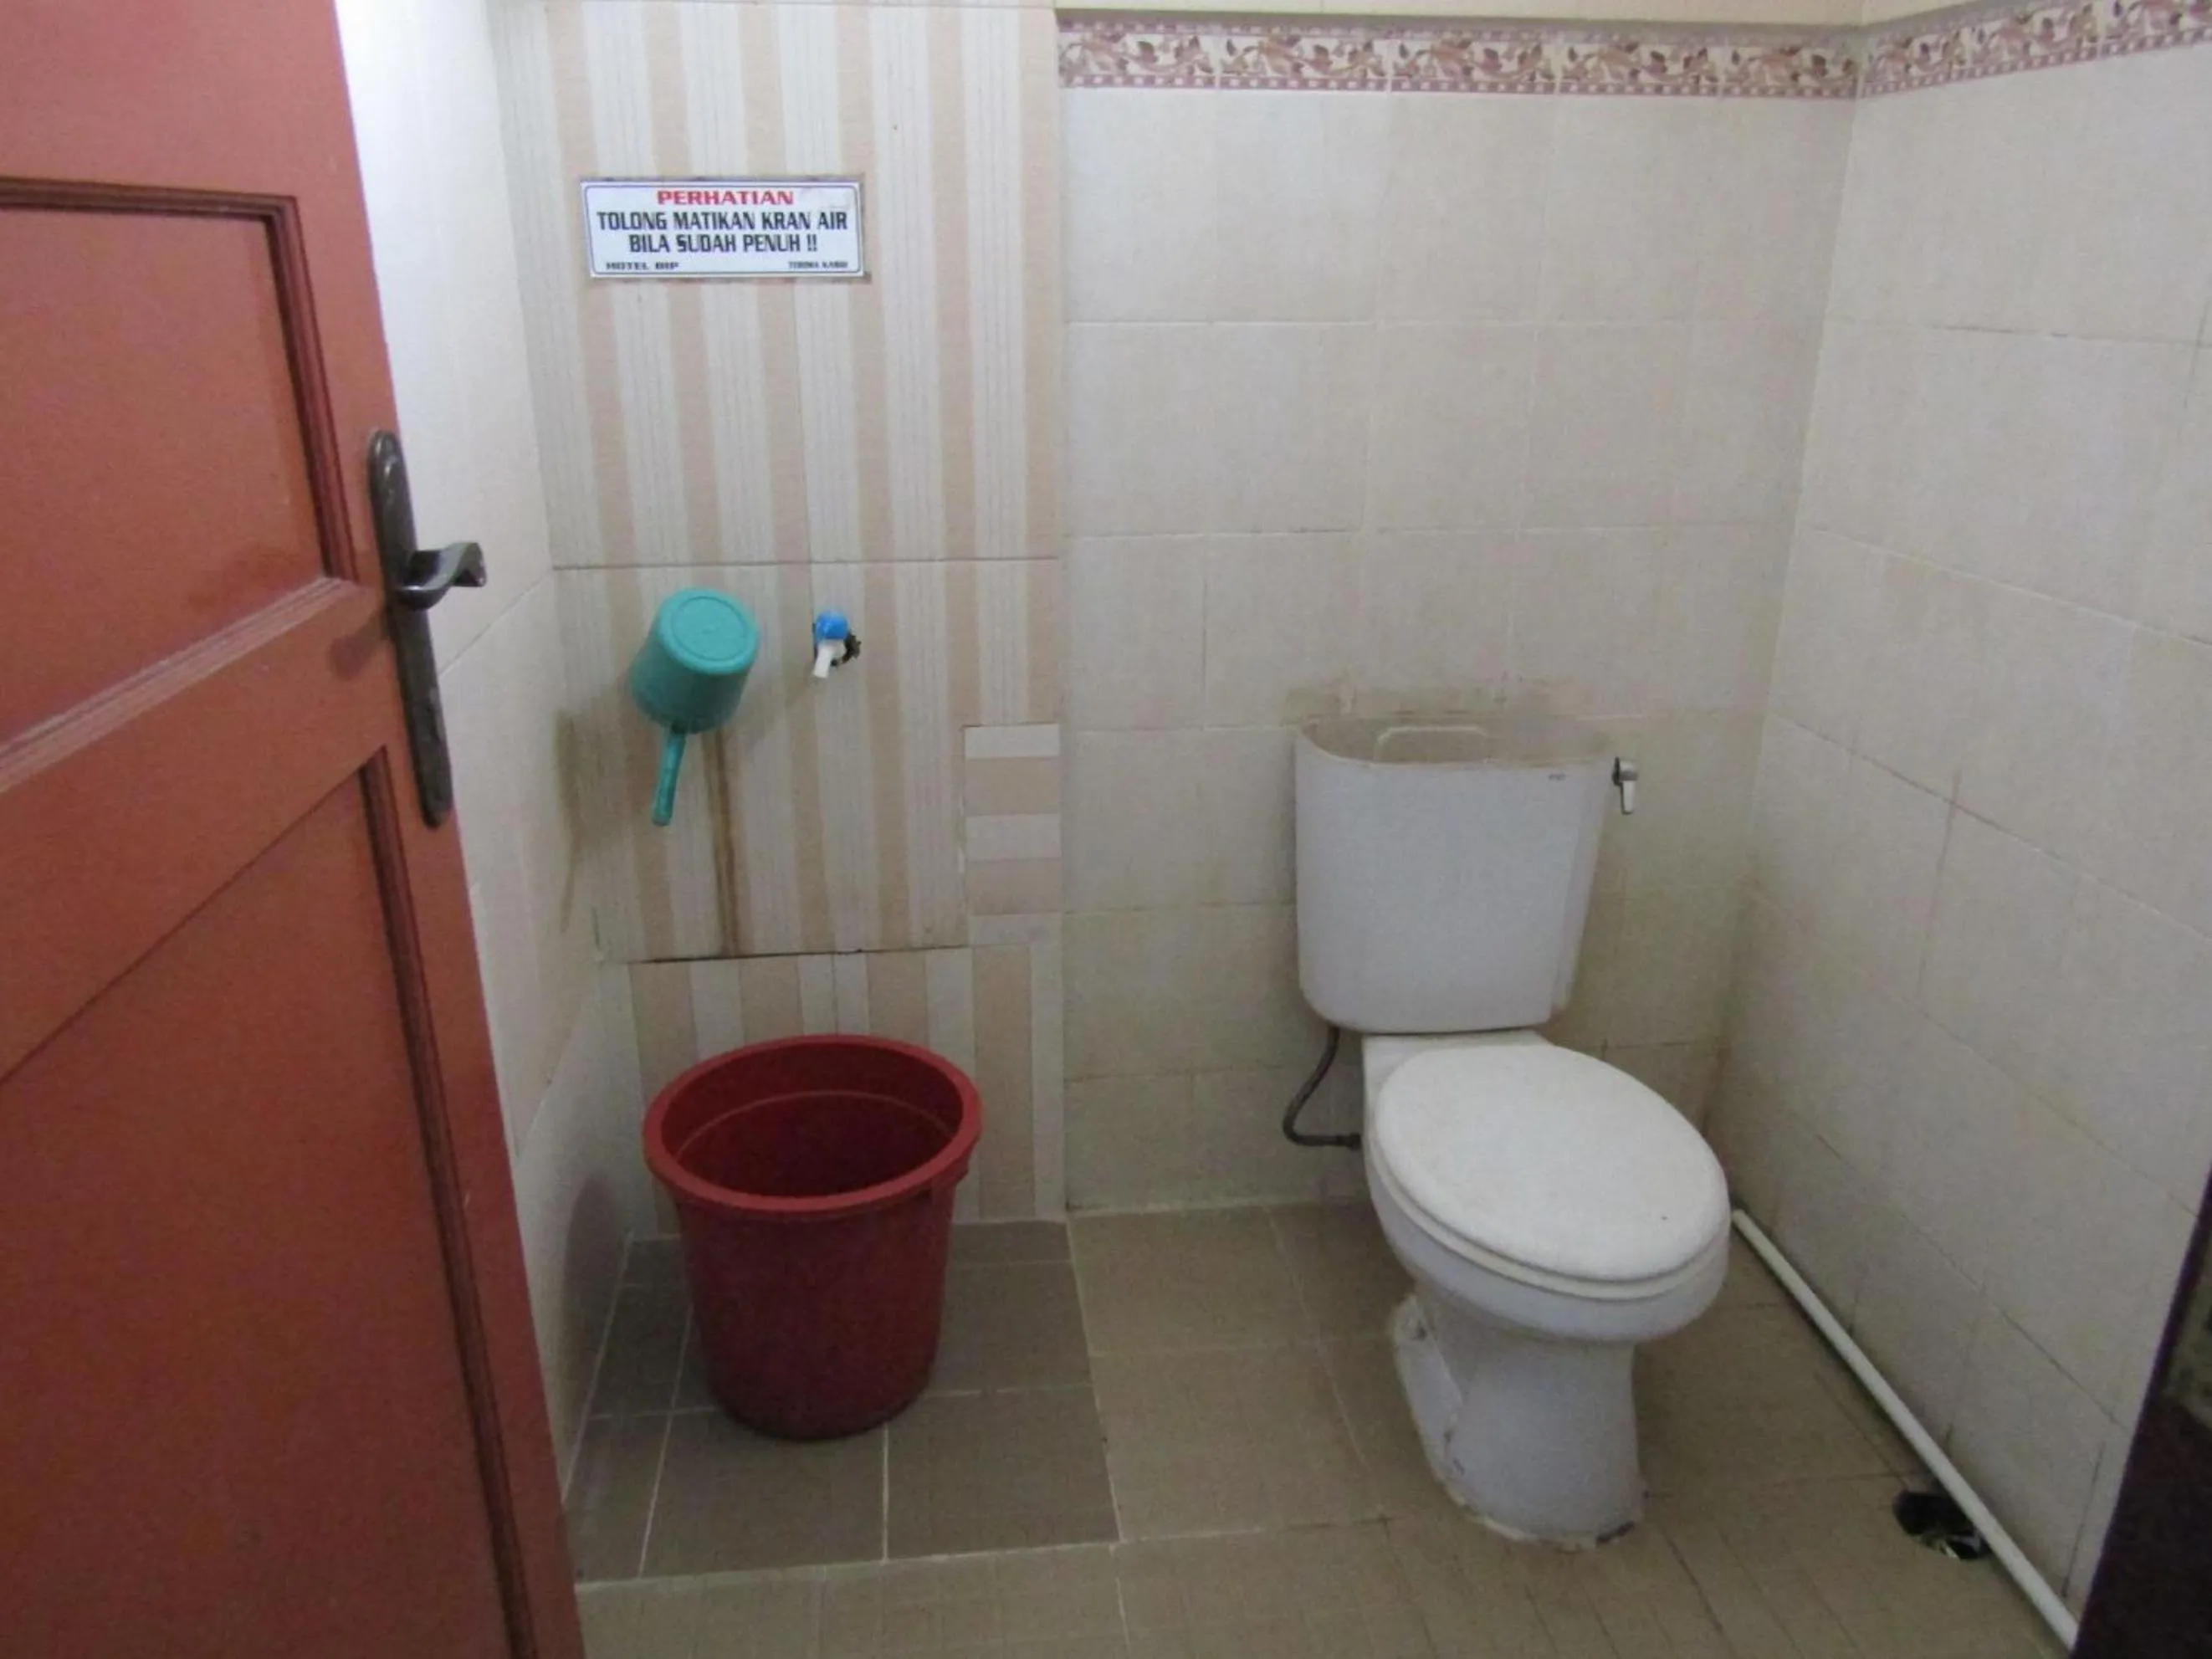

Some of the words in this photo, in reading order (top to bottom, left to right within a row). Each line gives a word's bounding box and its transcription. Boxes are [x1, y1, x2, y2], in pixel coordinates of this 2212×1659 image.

[657, 190, 793, 204] PERHATIAN
[597, 211, 667, 230] TOLONG
[673, 211, 755, 230] MATIKAN
[762, 211, 810, 230] KRAN
[817, 212, 847, 230] AIR
[629, 234, 669, 253] BILA
[677, 234, 736, 253] SUDAH
[743, 234, 801, 252] PENUH
